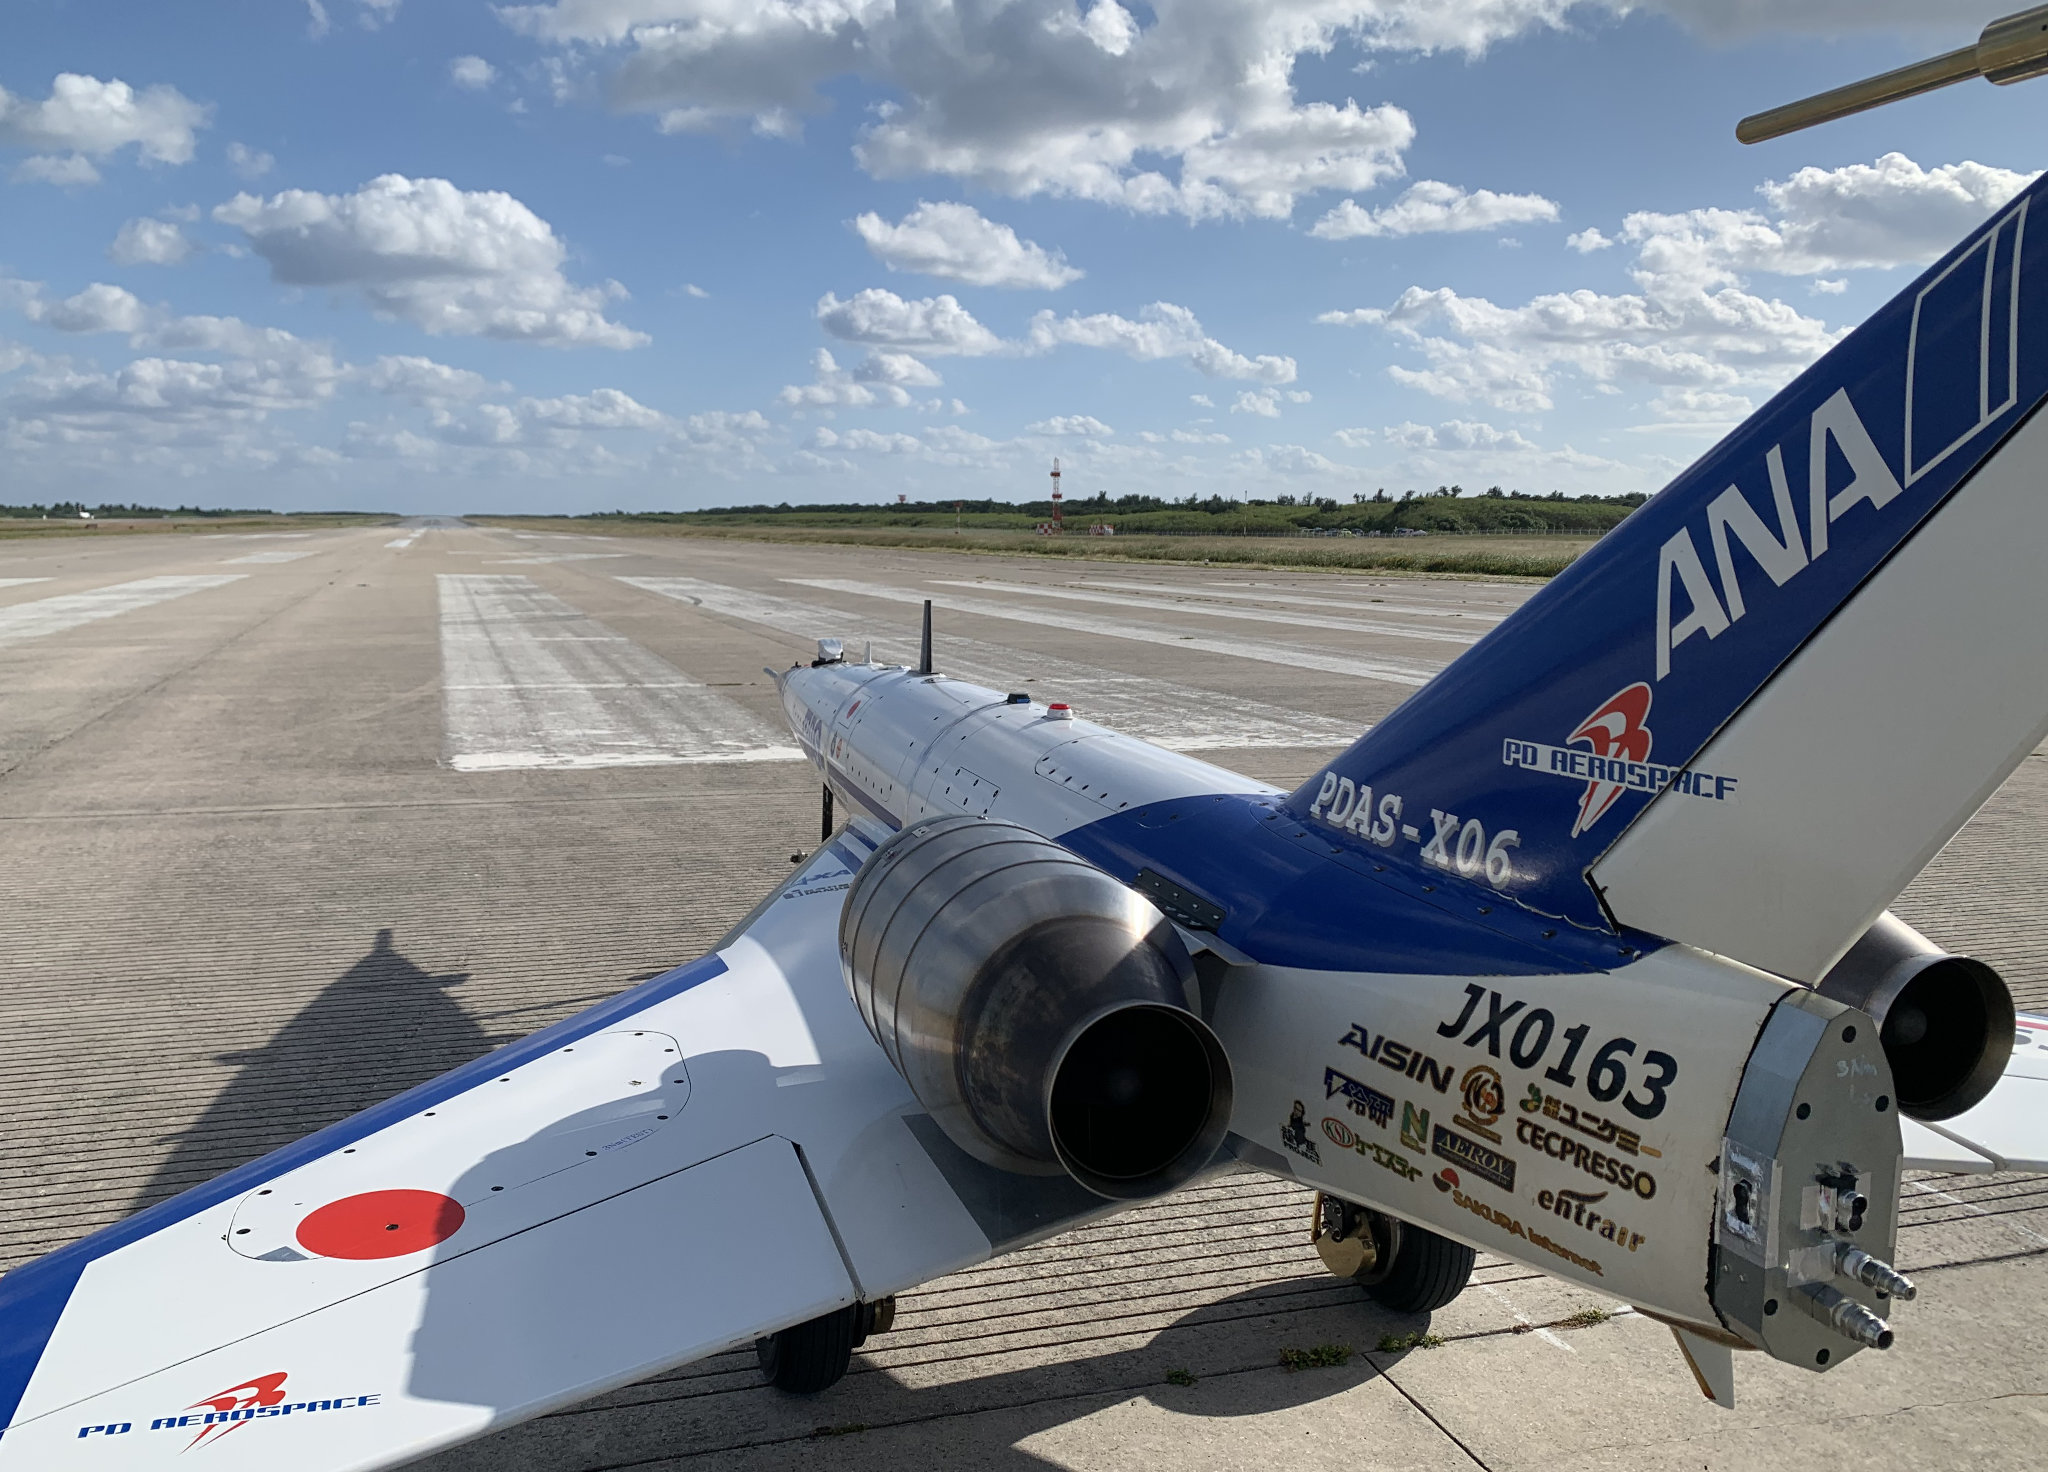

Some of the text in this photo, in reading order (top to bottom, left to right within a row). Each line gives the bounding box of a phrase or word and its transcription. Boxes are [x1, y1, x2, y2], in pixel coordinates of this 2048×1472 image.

[1656, 386, 1903, 682] ANA
[1503, 738, 1539, 768] PD
[1309, 770, 1522, 889] PDAS-X06
[1338, 1022, 1455, 1094] AISIN
[1436, 982, 1677, 1120] JX0163
[1516, 1116, 1657, 1200] TECPRESSO
[1452, 1189, 1528, 1240] SAKURA
[77, 1393, 381, 1439] PD AEROSPACE
